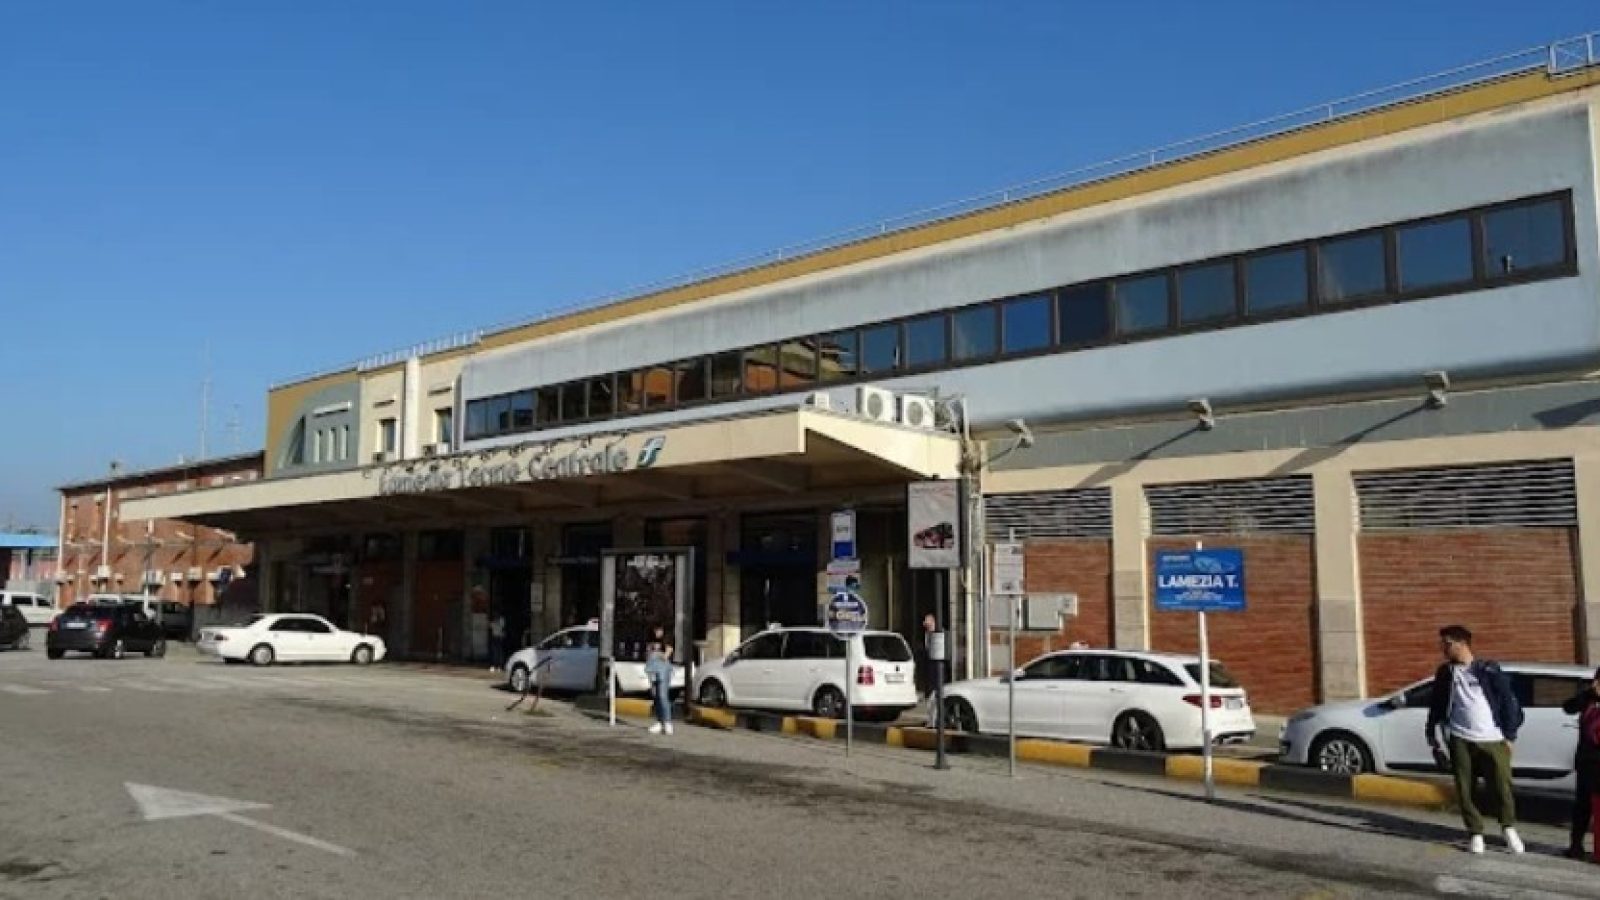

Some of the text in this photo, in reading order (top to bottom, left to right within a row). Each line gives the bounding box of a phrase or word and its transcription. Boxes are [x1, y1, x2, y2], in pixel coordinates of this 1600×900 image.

[528, 445, 628, 480] Centrale
[1158, 574, 1239, 588] LAMEZIA T.
